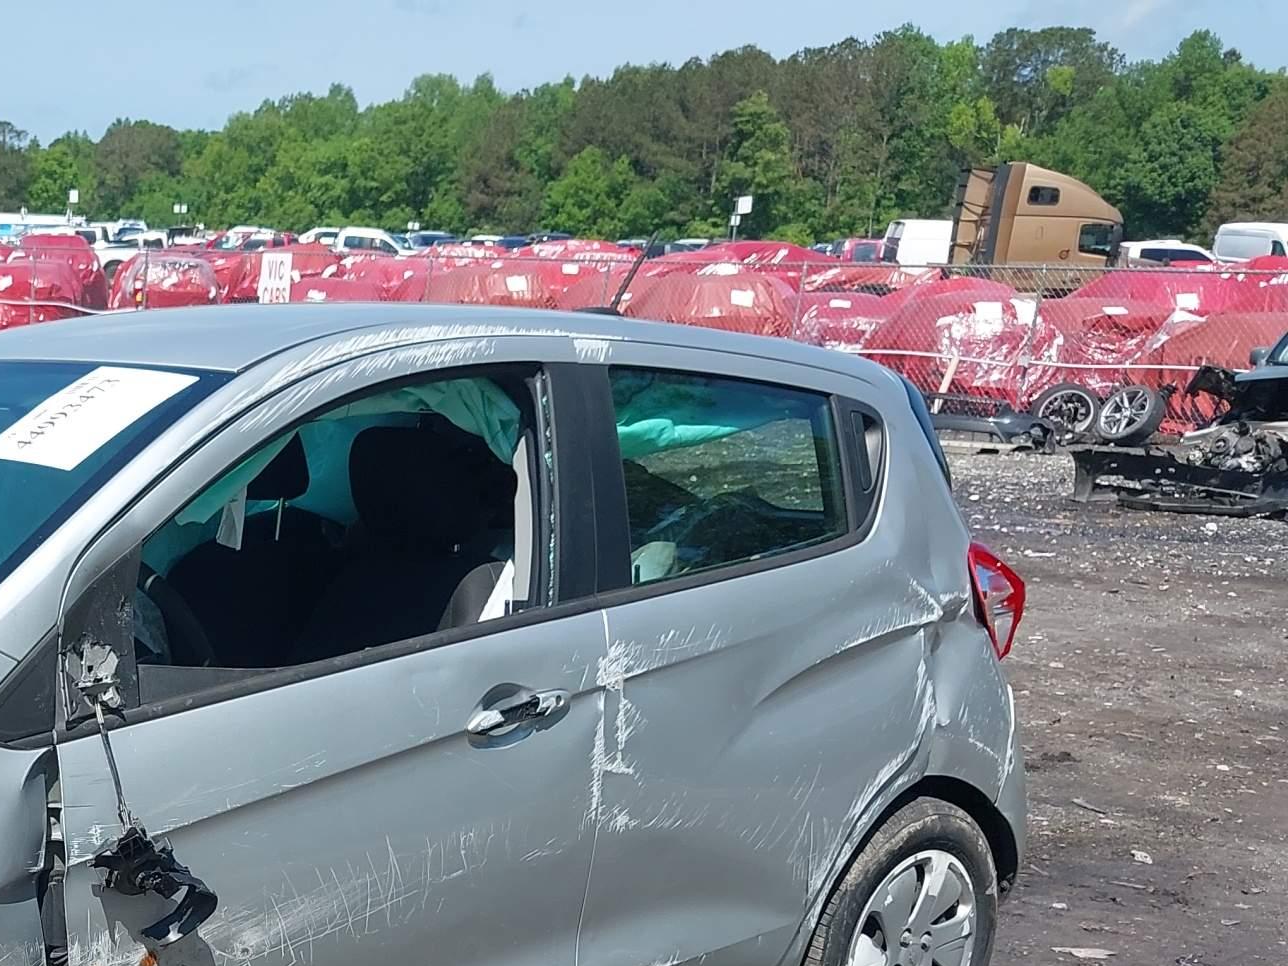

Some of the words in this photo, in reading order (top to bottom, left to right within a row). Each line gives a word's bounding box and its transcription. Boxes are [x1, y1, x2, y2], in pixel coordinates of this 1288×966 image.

[267, 259, 285, 281] VIC
[262, 286, 287, 304] CARS
[17, 379, 121, 449] 44993473
